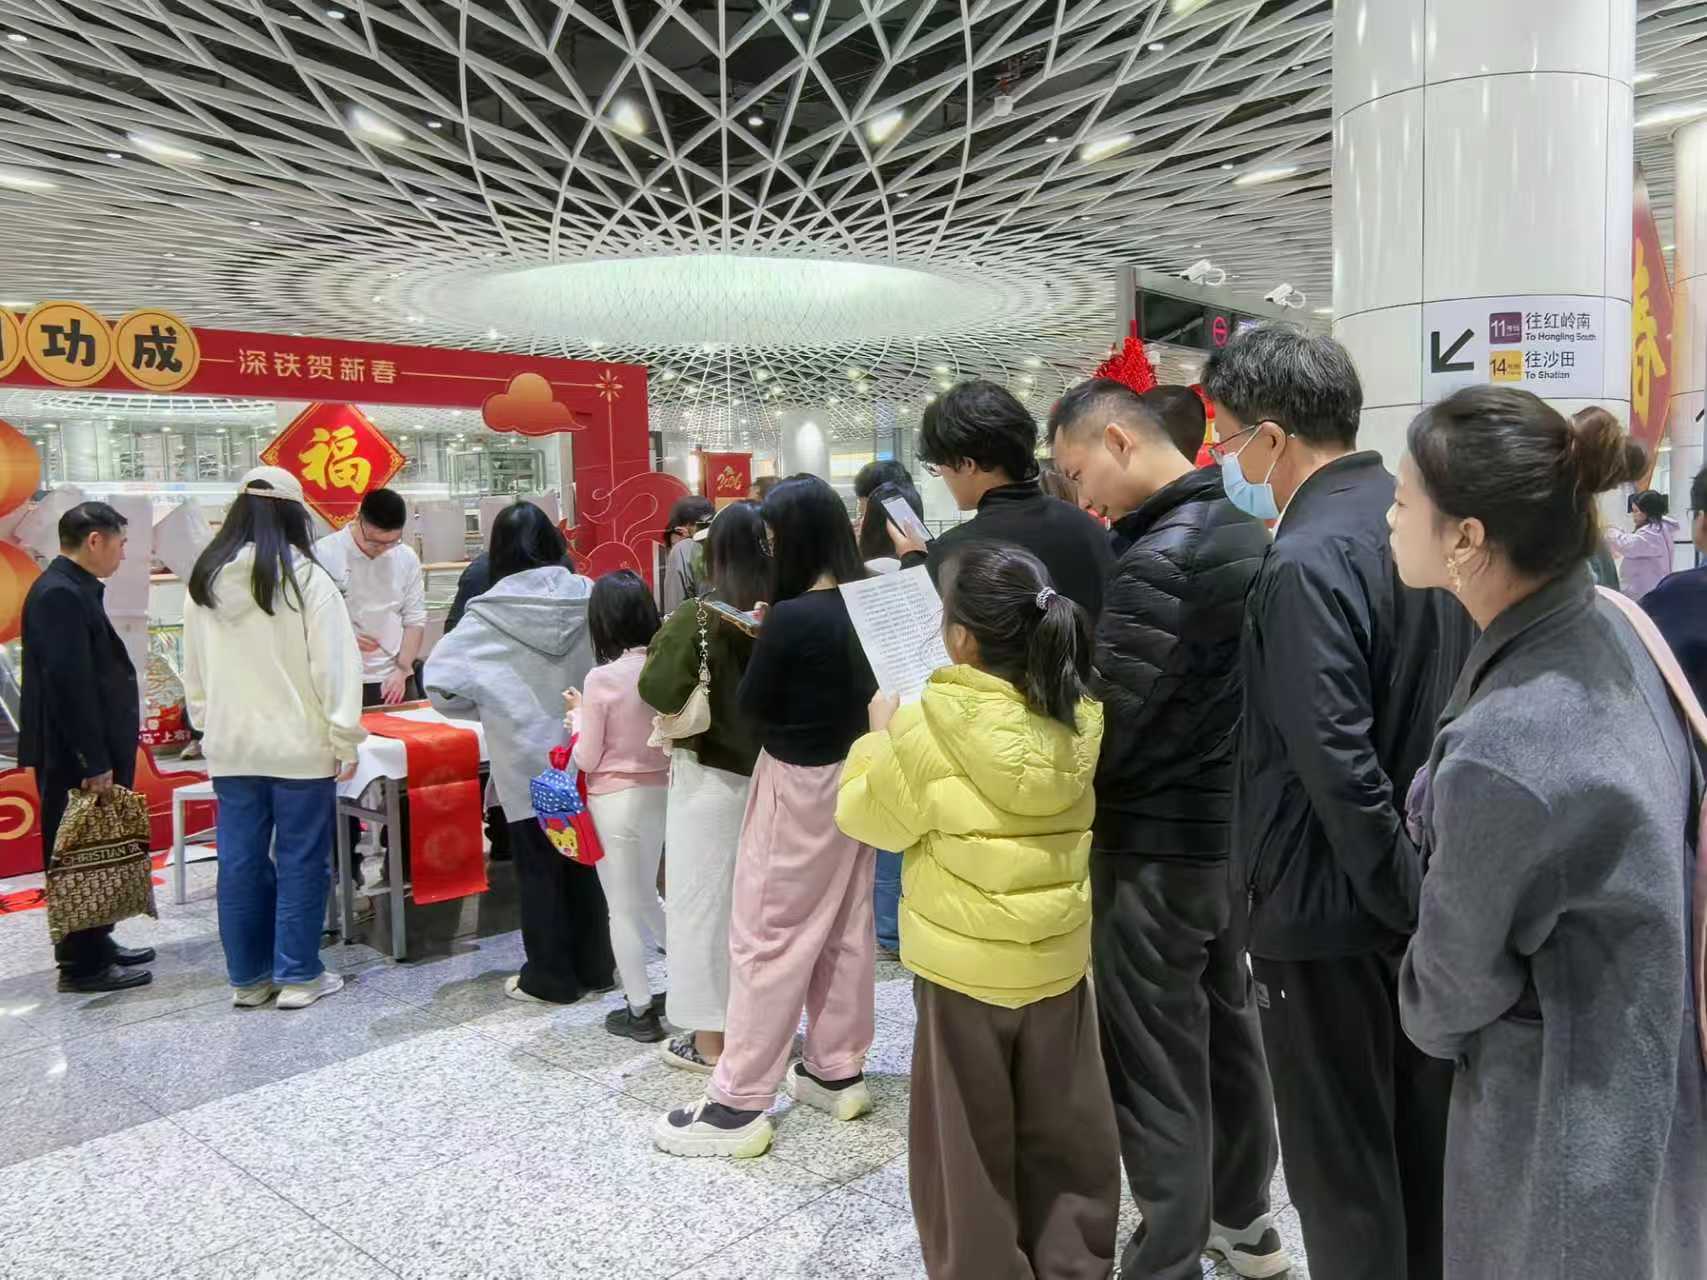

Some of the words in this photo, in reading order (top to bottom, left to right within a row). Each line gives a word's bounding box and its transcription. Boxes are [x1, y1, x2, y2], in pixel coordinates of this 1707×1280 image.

[1490, 320, 1506, 337] 11
[1525, 312, 1591, 330] 往红岭南
[0, 315, 183, 374] 功成
[1526, 333, 1536, 341] To
[1538, 332, 1575, 342] Hongling
[1577, 333, 1596, 341] South
[239, 348, 397, 384] 深铁贺新春
[1490, 358, 1506, 377] 14
[1525, 351, 1574, 368] 往沙田
[1525, 371, 1536, 379] To
[1538, 371, 1570, 379] Shatian
[297, 425, 373, 494] 福
[62, 846, 126, 866] CHRISTIAN
